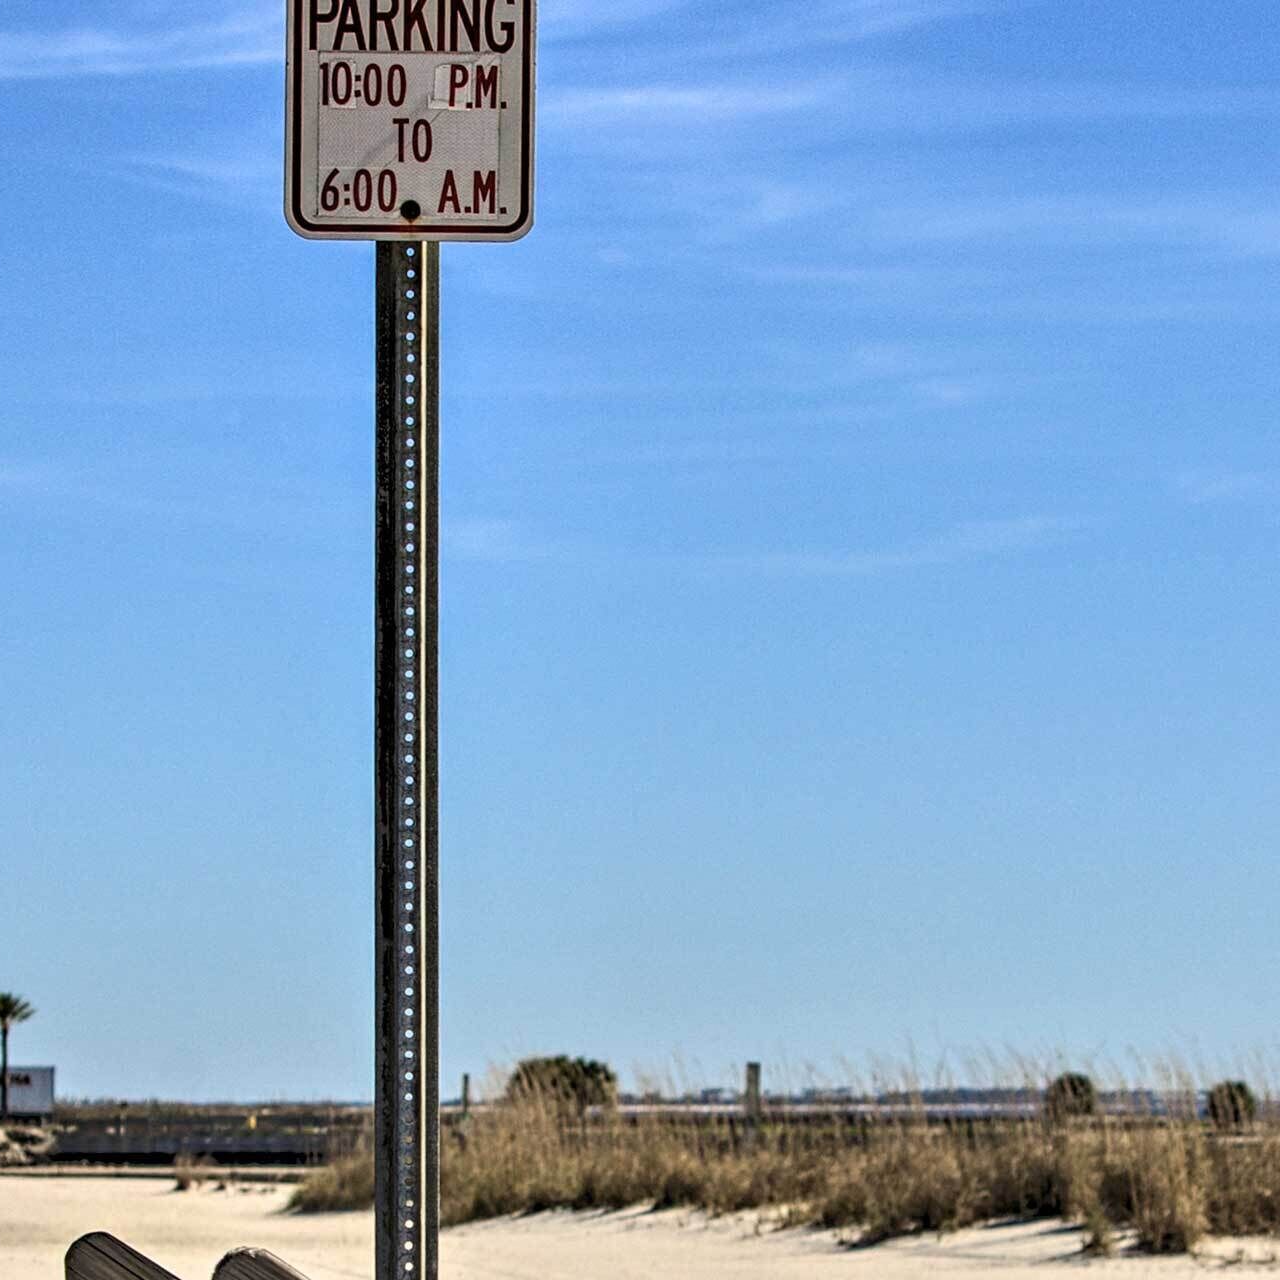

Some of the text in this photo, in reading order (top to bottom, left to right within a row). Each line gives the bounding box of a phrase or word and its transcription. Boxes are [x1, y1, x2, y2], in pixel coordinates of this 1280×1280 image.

[309, 0, 515, 53] PARKING
[320, 62, 507, 109] 10:00 P.M.
[393, 118, 433, 163] TO
[321, 168, 507, 214] 6:00 A.M.
